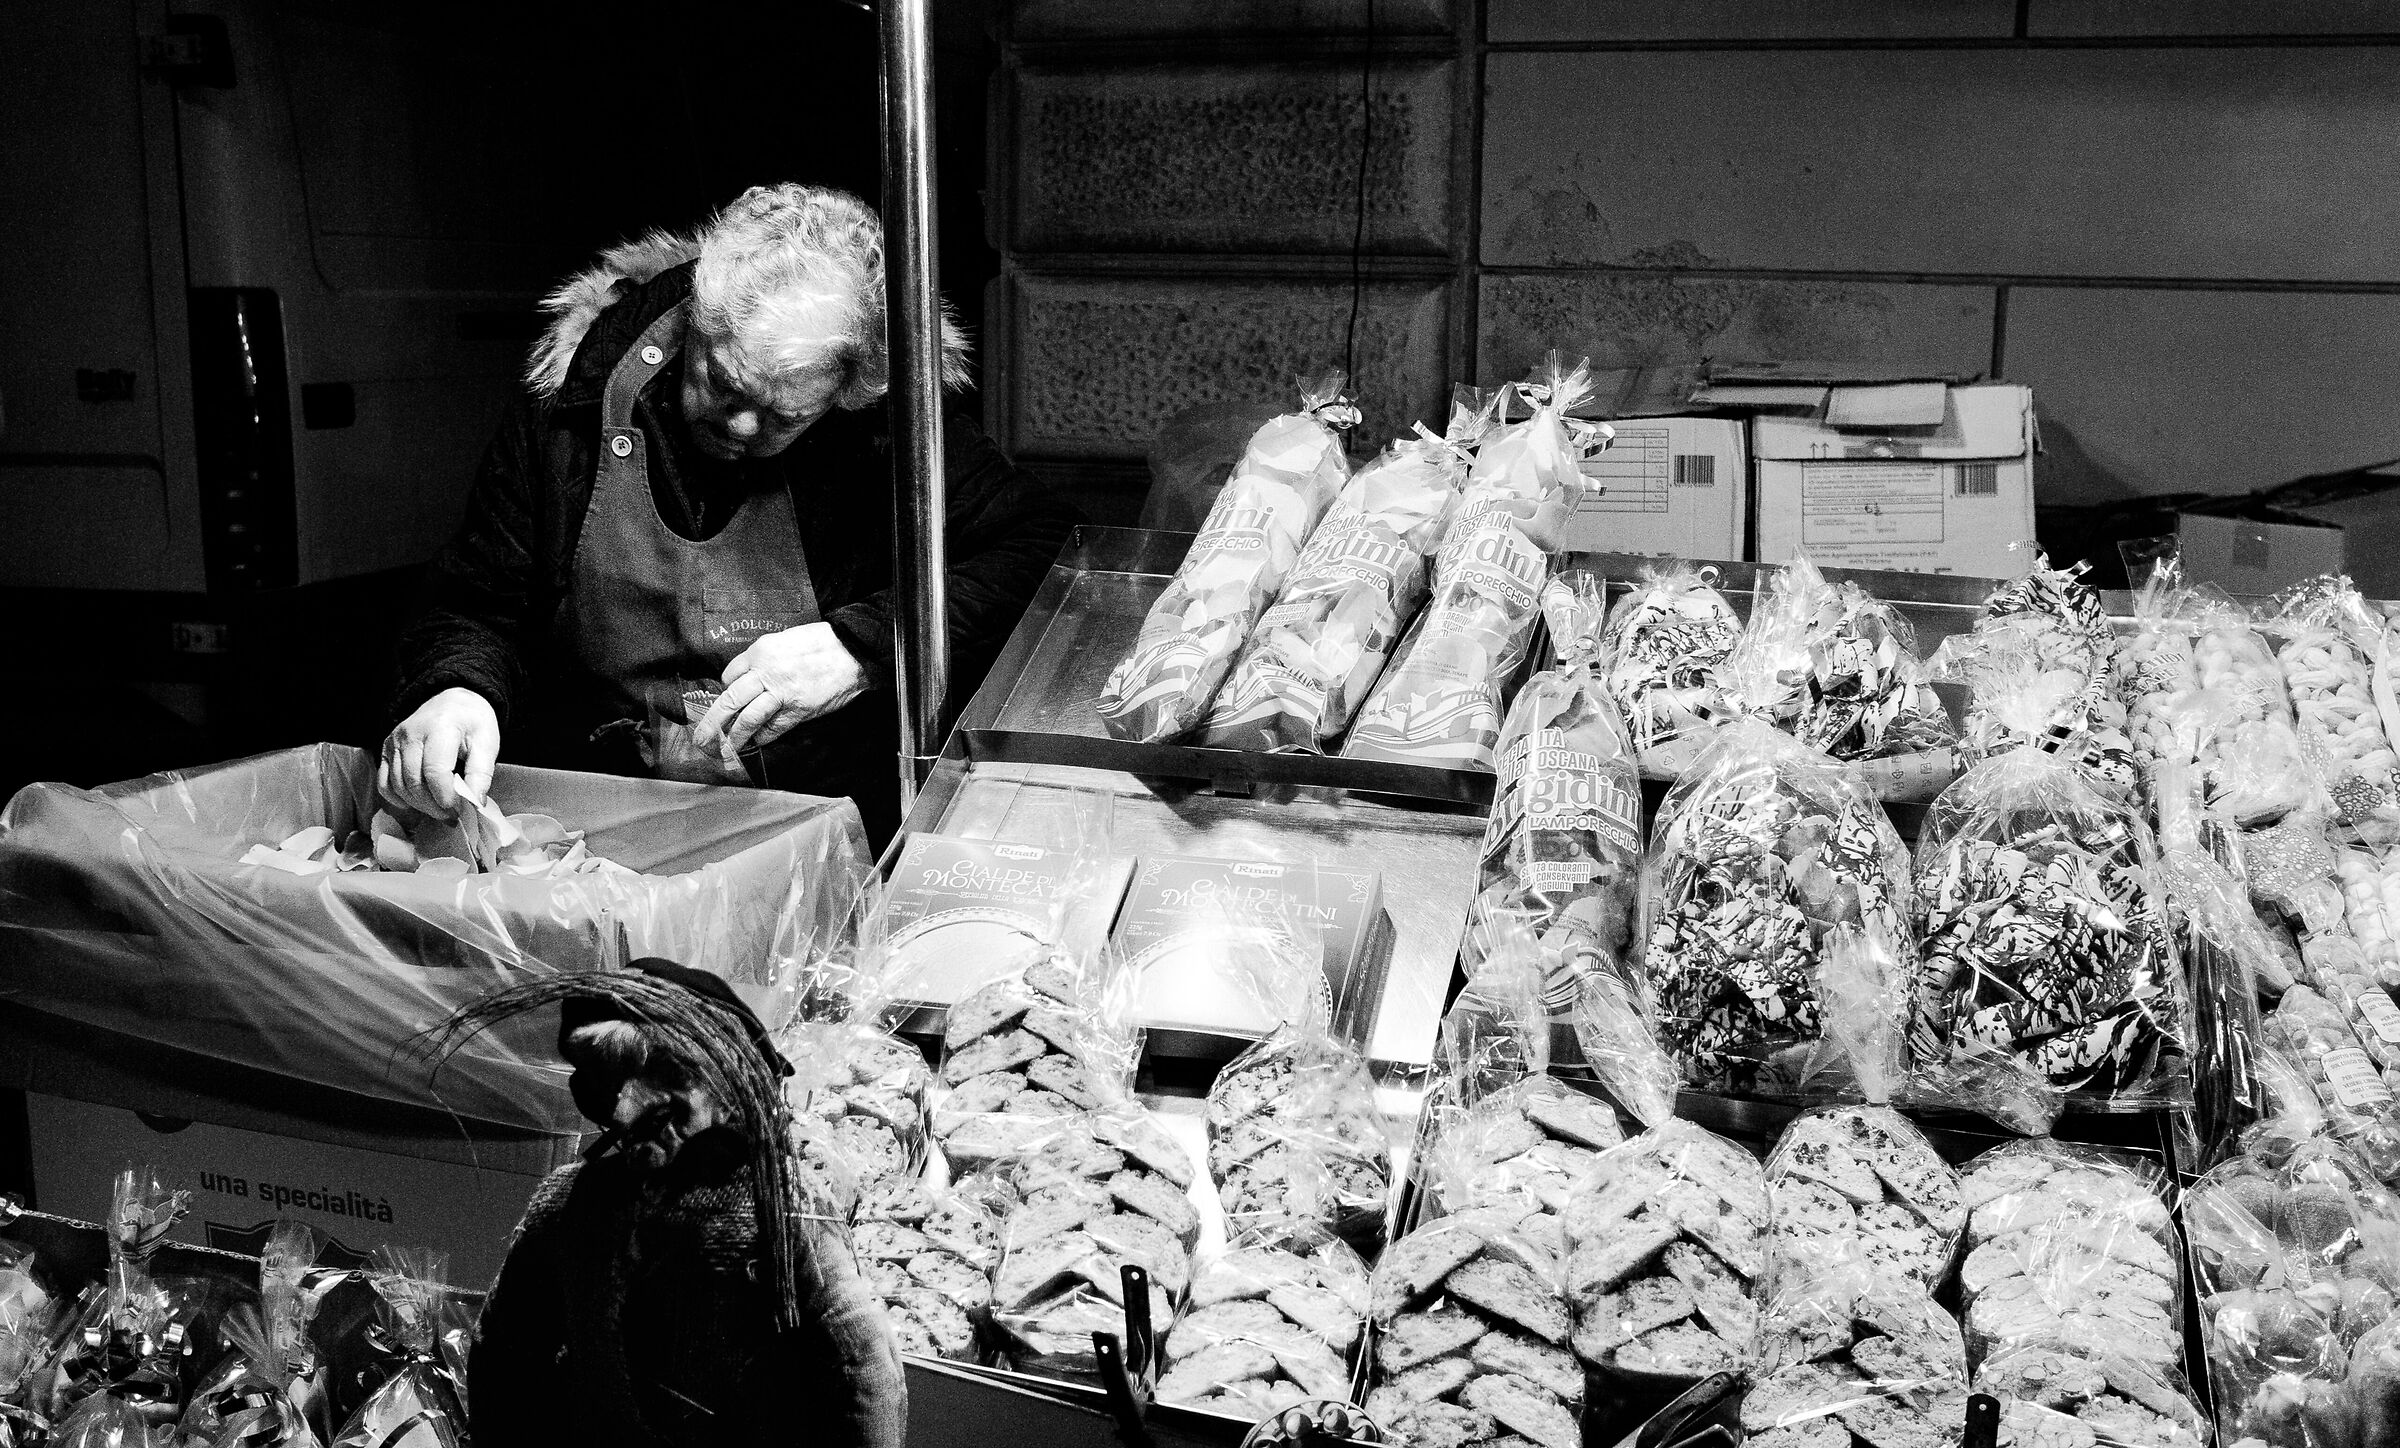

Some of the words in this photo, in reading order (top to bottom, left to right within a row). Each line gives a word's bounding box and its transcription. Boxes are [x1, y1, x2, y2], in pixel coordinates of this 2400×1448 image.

[1197, 503, 1275, 535] dini
[1190, 538, 1262, 554] ORECCHIO
[1299, 529, 1408, 575] gidini
[1441, 531, 1546, 588] gidini
[1308, 566, 1389, 591] ORECCHIO
[709, 625, 728, 640] LA
[1538, 750, 1598, 772] OSCANA
[1530, 817, 1638, 853] LAMPORECCHIO
[923, 870, 1061, 899] MONTECAT
[952, 860, 1036, 884] CIALDE
[200, 1171, 248, 1197] una
[259, 1182, 394, 1223] specialità
